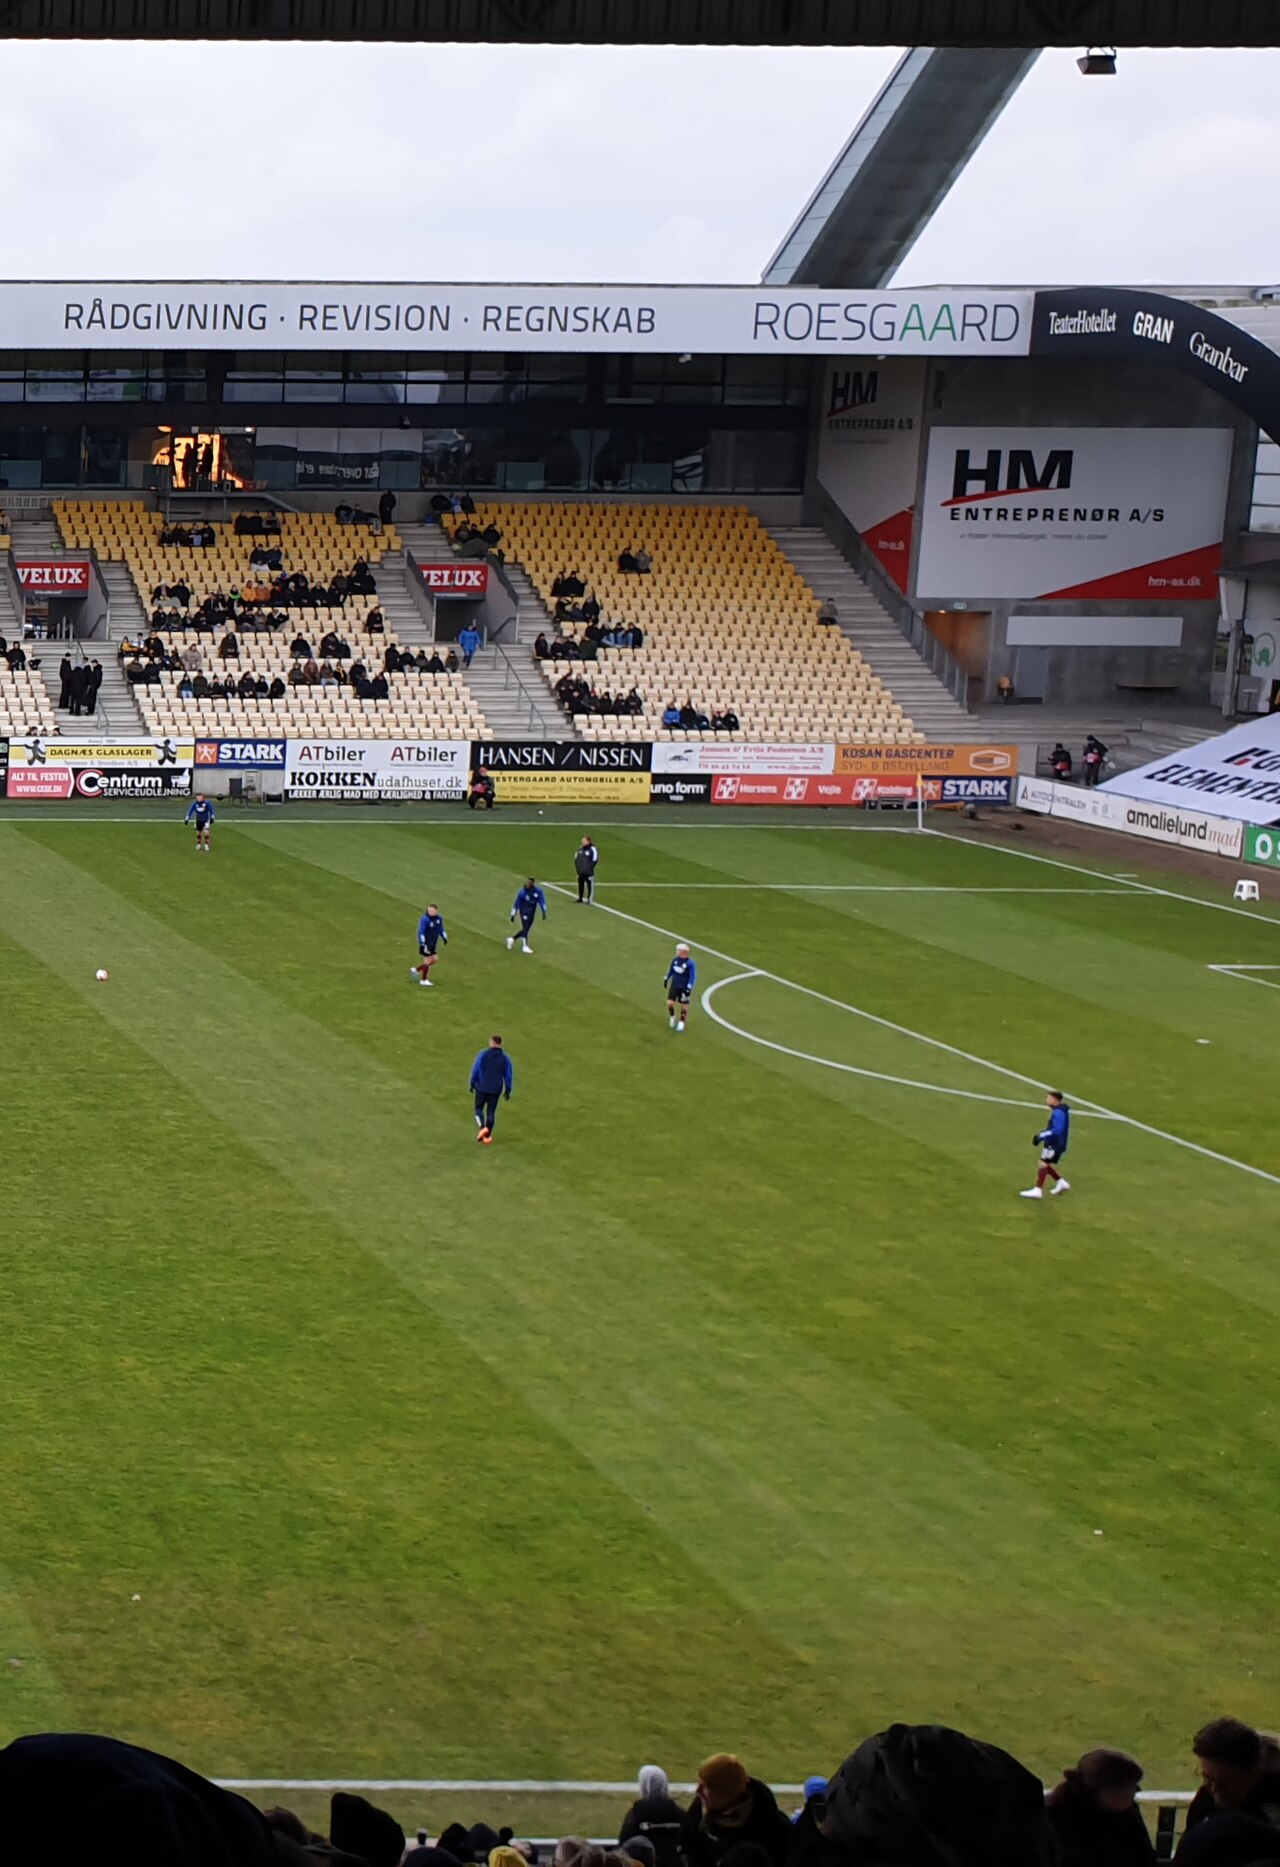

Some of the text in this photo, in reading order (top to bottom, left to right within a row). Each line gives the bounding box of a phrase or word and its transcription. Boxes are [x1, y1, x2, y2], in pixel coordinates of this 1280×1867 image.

[64, 298, 655, 333] RÅDGIVNING REVISION REGNSKAB
[753, 302, 1020, 342] ROESGAARD
[1049, 310, 1117, 335] TeaterHotellet
[1133, 310, 1174, 344] GRAN
[1189, 331, 1249, 383] Granbar
[830, 371, 878, 411] HM
[952, 449, 1073, 498] HM
[950, 507, 1165, 523] ENTREPRENØR A/S
[16, 567, 83, 584] VELUX
[1148, 574, 1202, 589] hm-as.dk
[50, 748, 152, 756] DAGNÆS GLASLAGER
[219, 743, 284, 761] STARK
[298, 745, 366, 763] ATbiler
[391, 746, 458, 763] ATbiler
[480, 747, 555, 765] HANSEN
[579, 748, 643, 766] NISSEN
[842, 748, 955, 759] KOSAN GASCENTER
[11, 772, 25, 781] ALT
[79, 771, 163, 791] Centrum
[377, 774, 463, 788] udafhuset.dk
[559, 776, 626, 784] AUTOMOBILER
[102, 788, 191, 797] SERVICEUDLEJNING
[343, 791, 360, 799] MAD
[362, 791, 379, 800] MED
[651, 782, 704, 794] uno form
[944, 780, 1007, 796] STARK
[1127, 808, 1241, 848] amalielund mad
